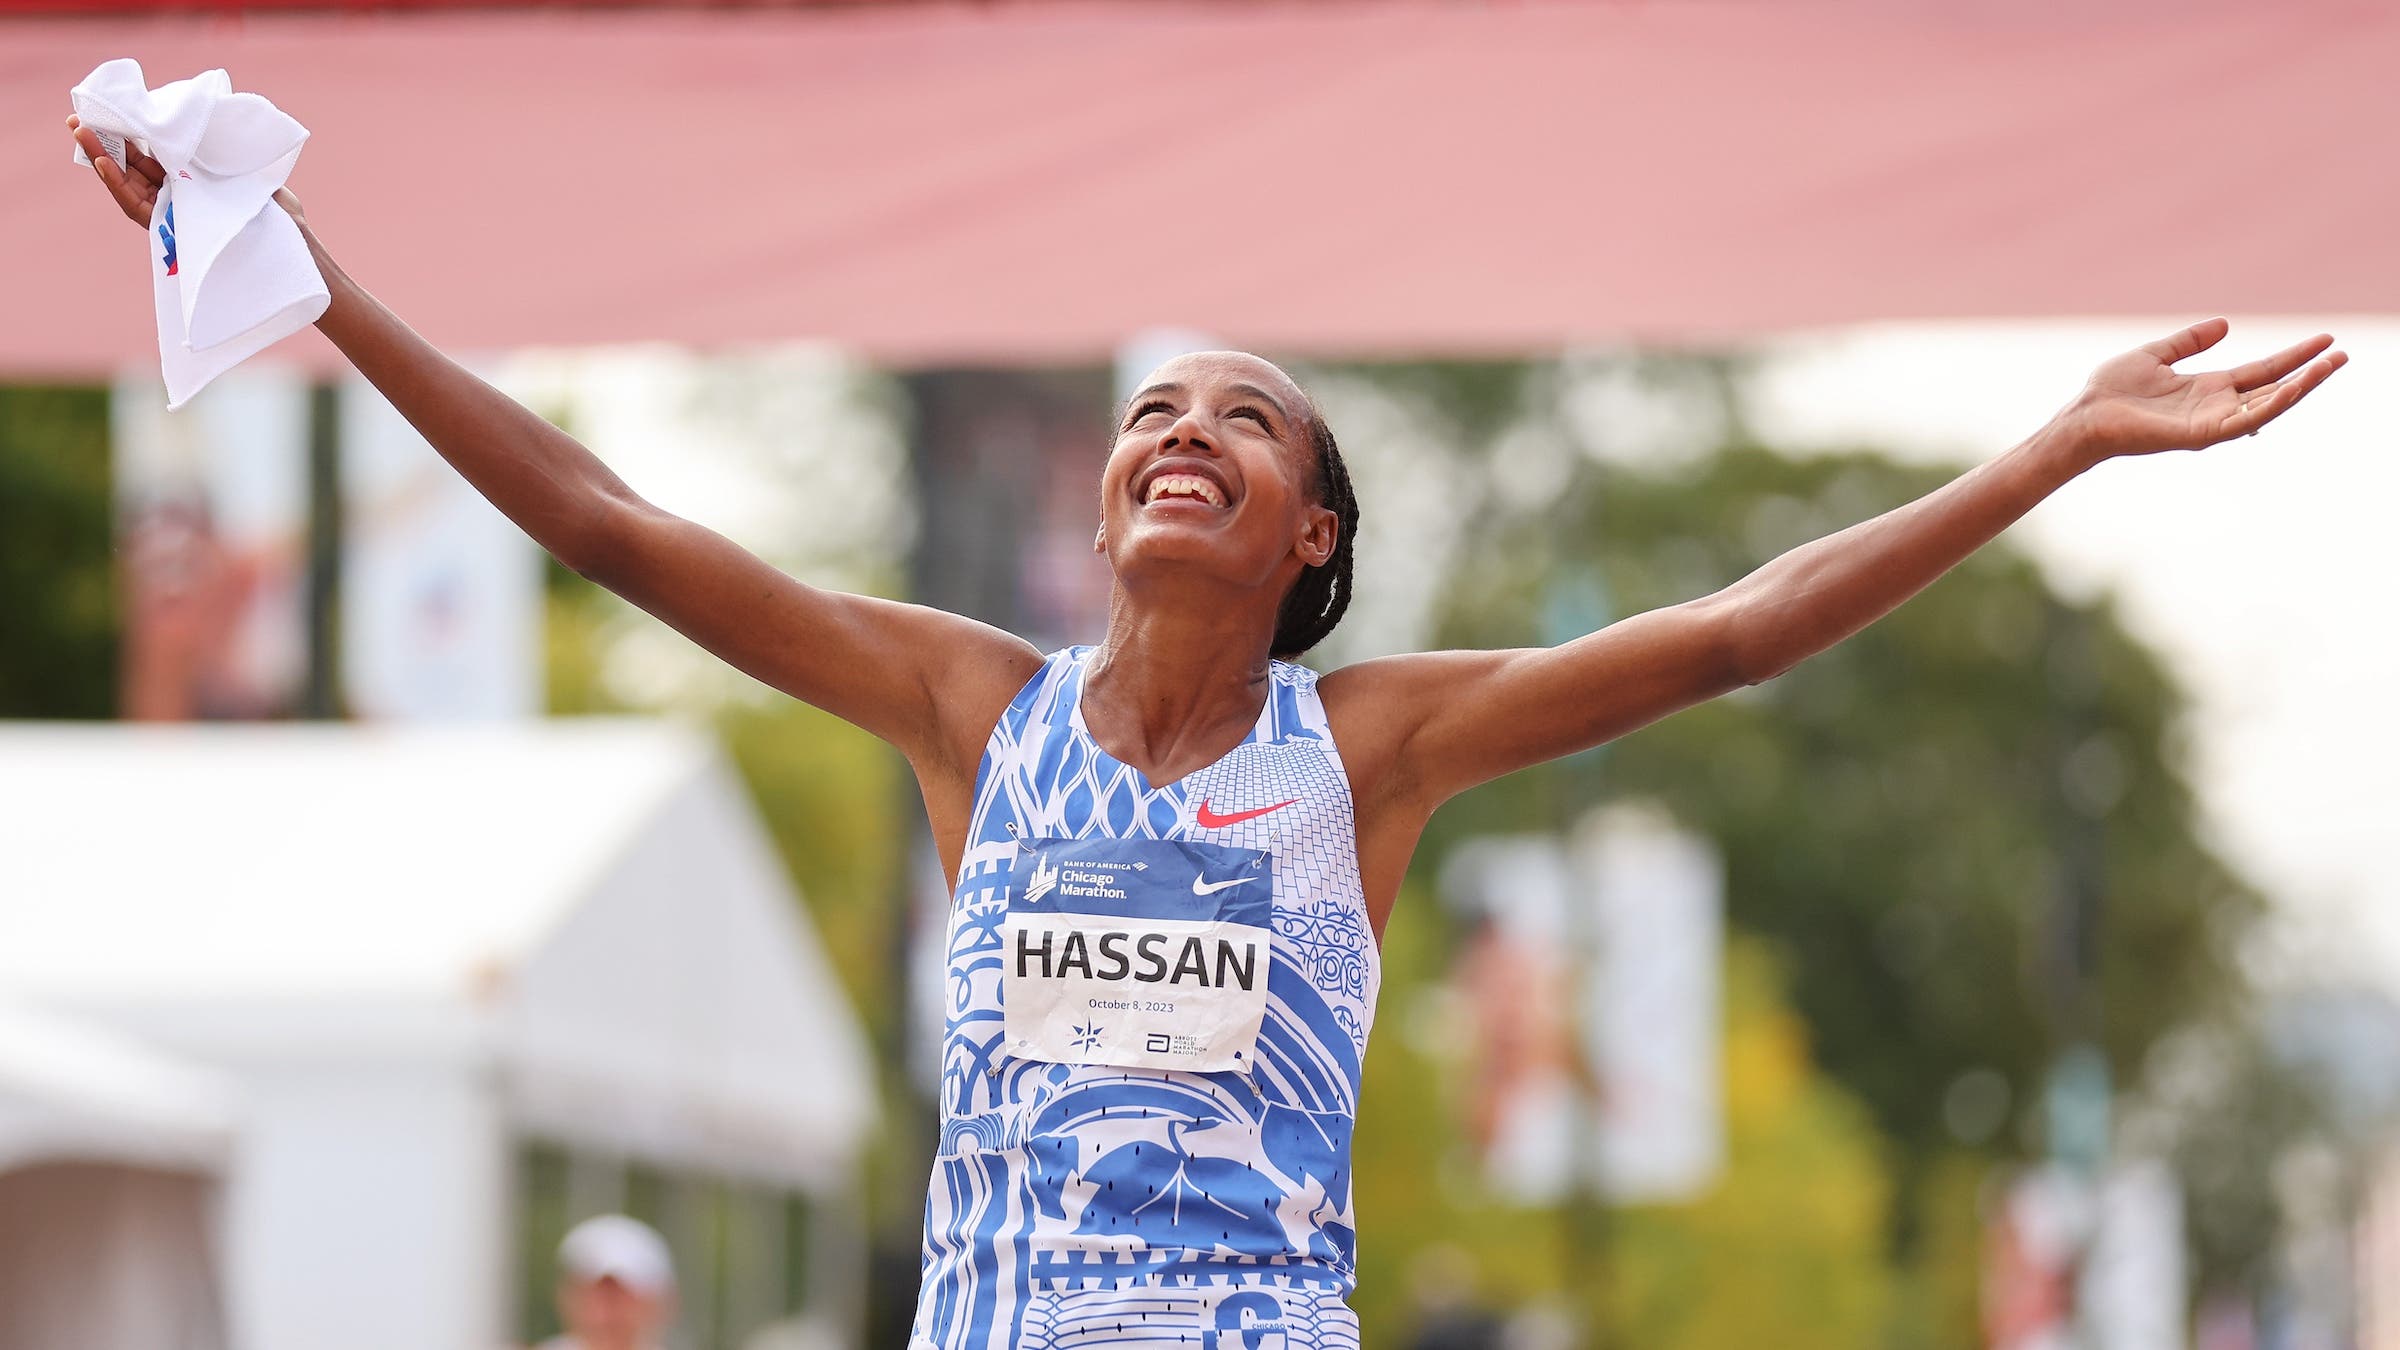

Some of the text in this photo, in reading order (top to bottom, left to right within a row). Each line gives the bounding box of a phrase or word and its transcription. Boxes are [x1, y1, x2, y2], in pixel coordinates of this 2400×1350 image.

[1096, 862, 1132, 871] AMERICA
[1062, 870, 1114, 886] Chicago
[1016, 929, 1256, 991] HASSAN
[1089, 998, 1174, 1013] October 8, 2023
